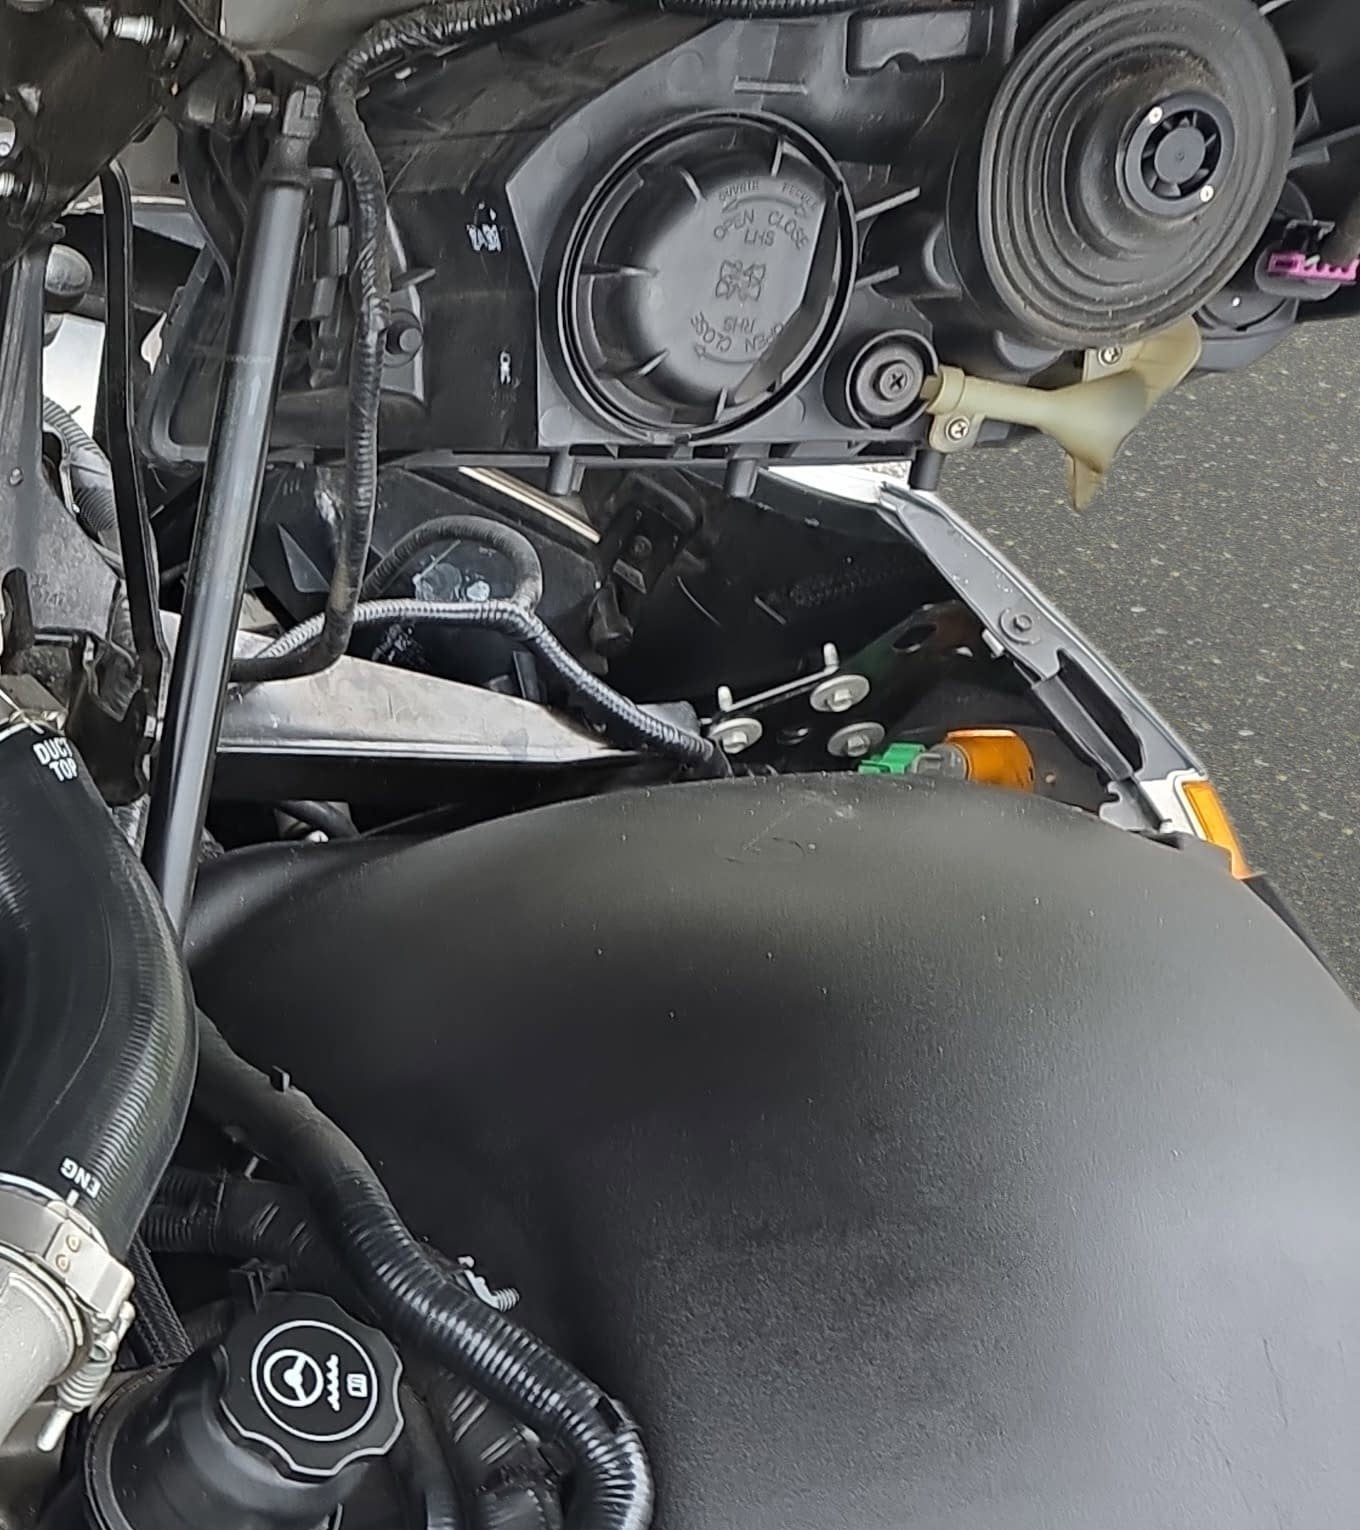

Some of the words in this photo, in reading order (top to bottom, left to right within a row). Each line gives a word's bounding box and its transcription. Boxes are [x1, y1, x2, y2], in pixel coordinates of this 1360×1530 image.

[713, 208, 755, 240] OPEN
[767, 210, 810, 250] CLOSE
[32, 736, 74, 767] DUCT
[48, 757, 78, 782] TOP
[59, 1156, 103, 1199] ENG
